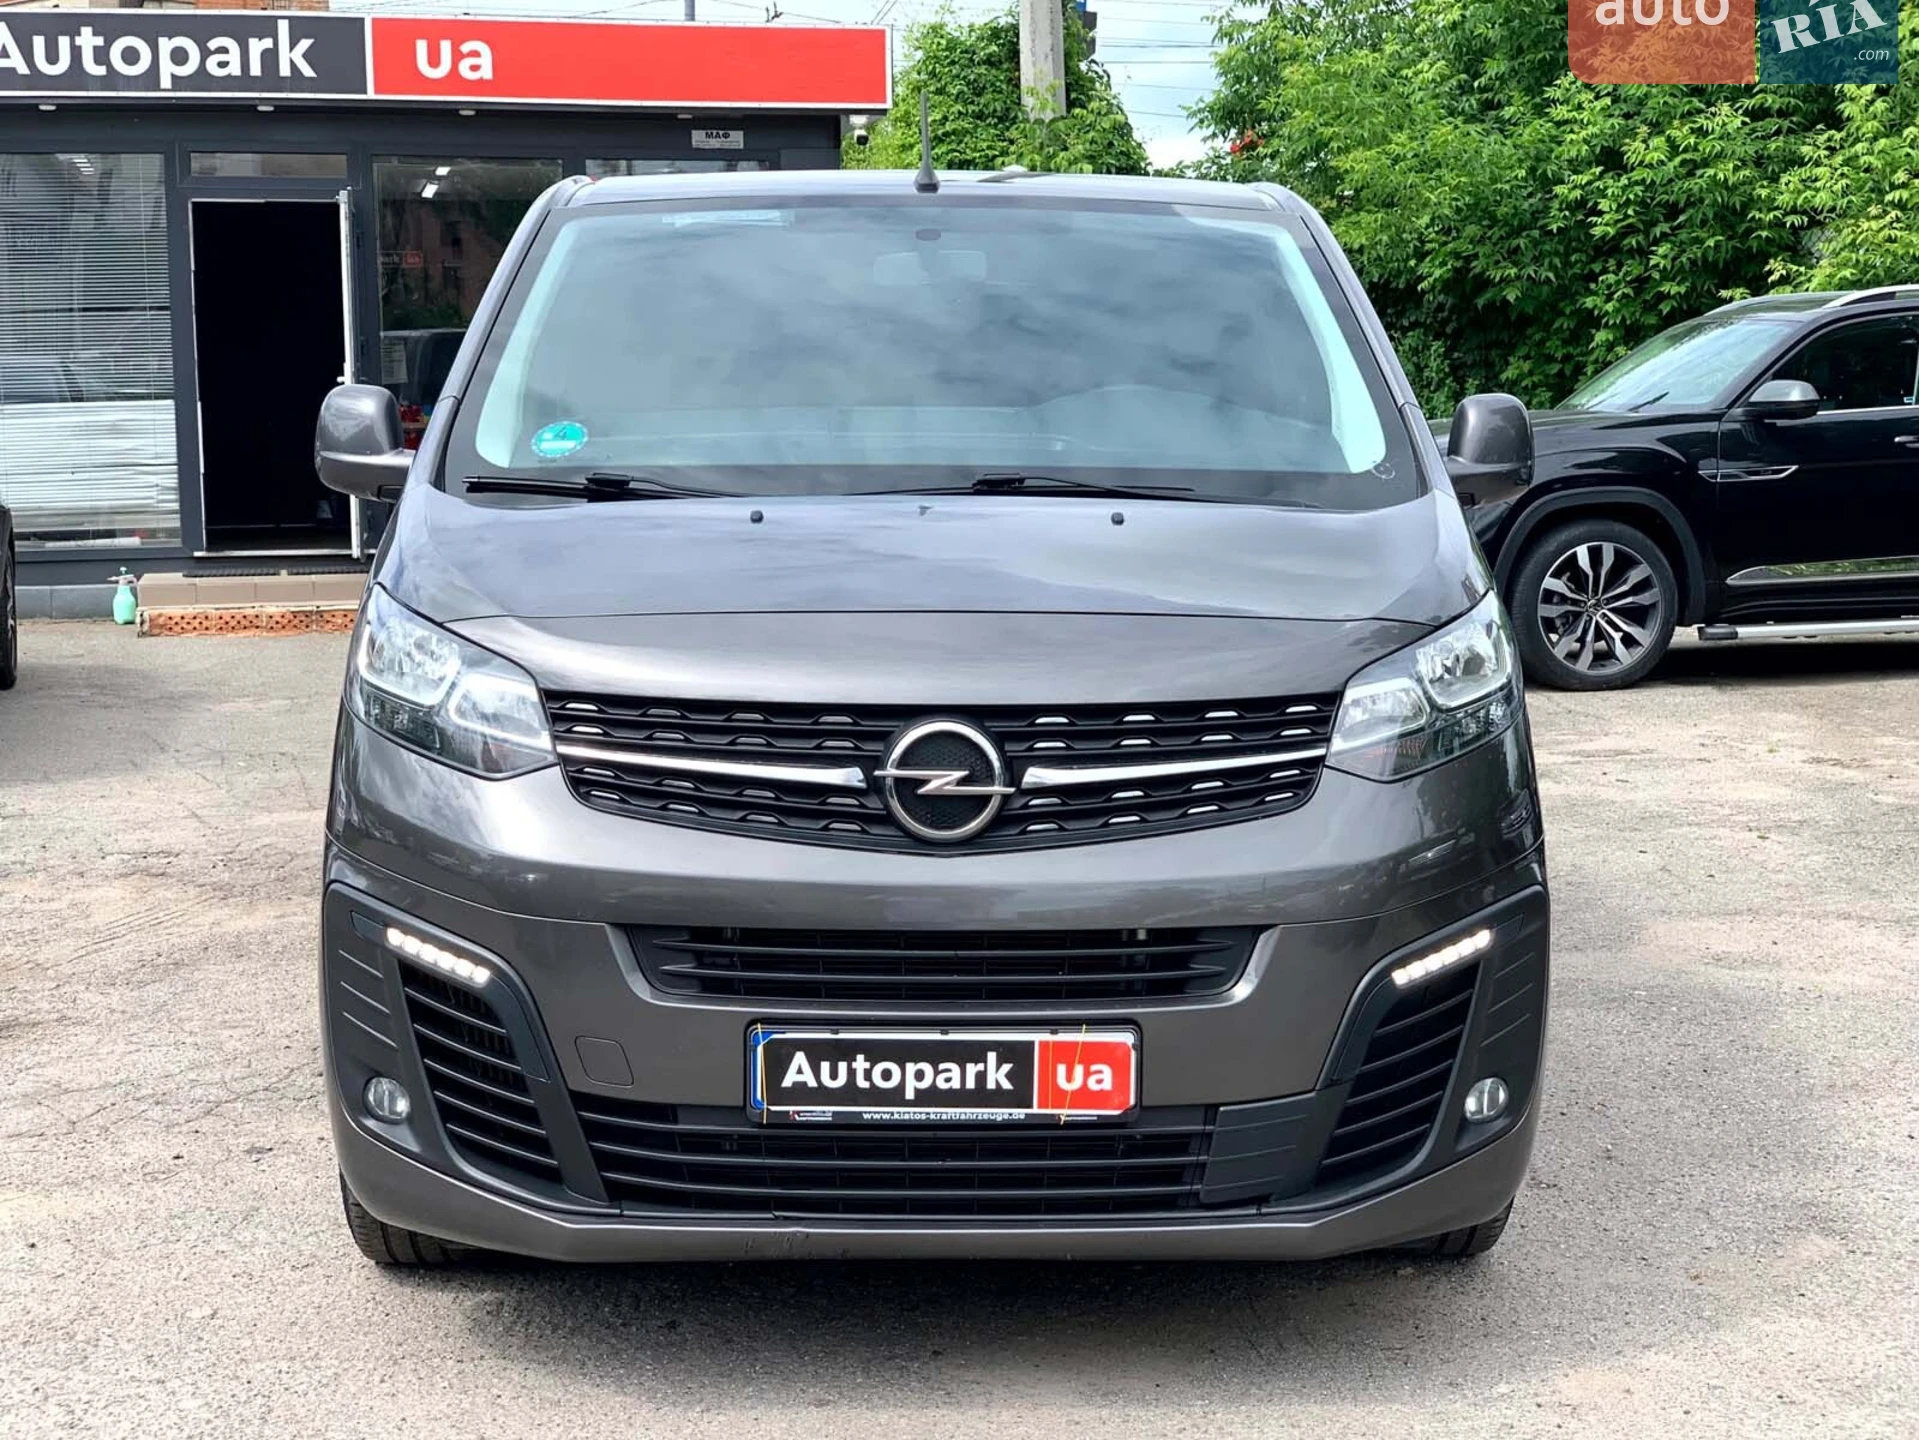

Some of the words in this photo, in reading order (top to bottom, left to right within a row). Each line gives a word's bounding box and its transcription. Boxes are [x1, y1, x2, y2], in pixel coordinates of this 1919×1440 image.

[0, 18, 318, 90] Autopark
[415, 39, 494, 81] ua
[705, 131, 731, 140] МАФ
[781, 1051, 1014, 1100] Autopark
[1056, 1062, 1113, 1091] ua
